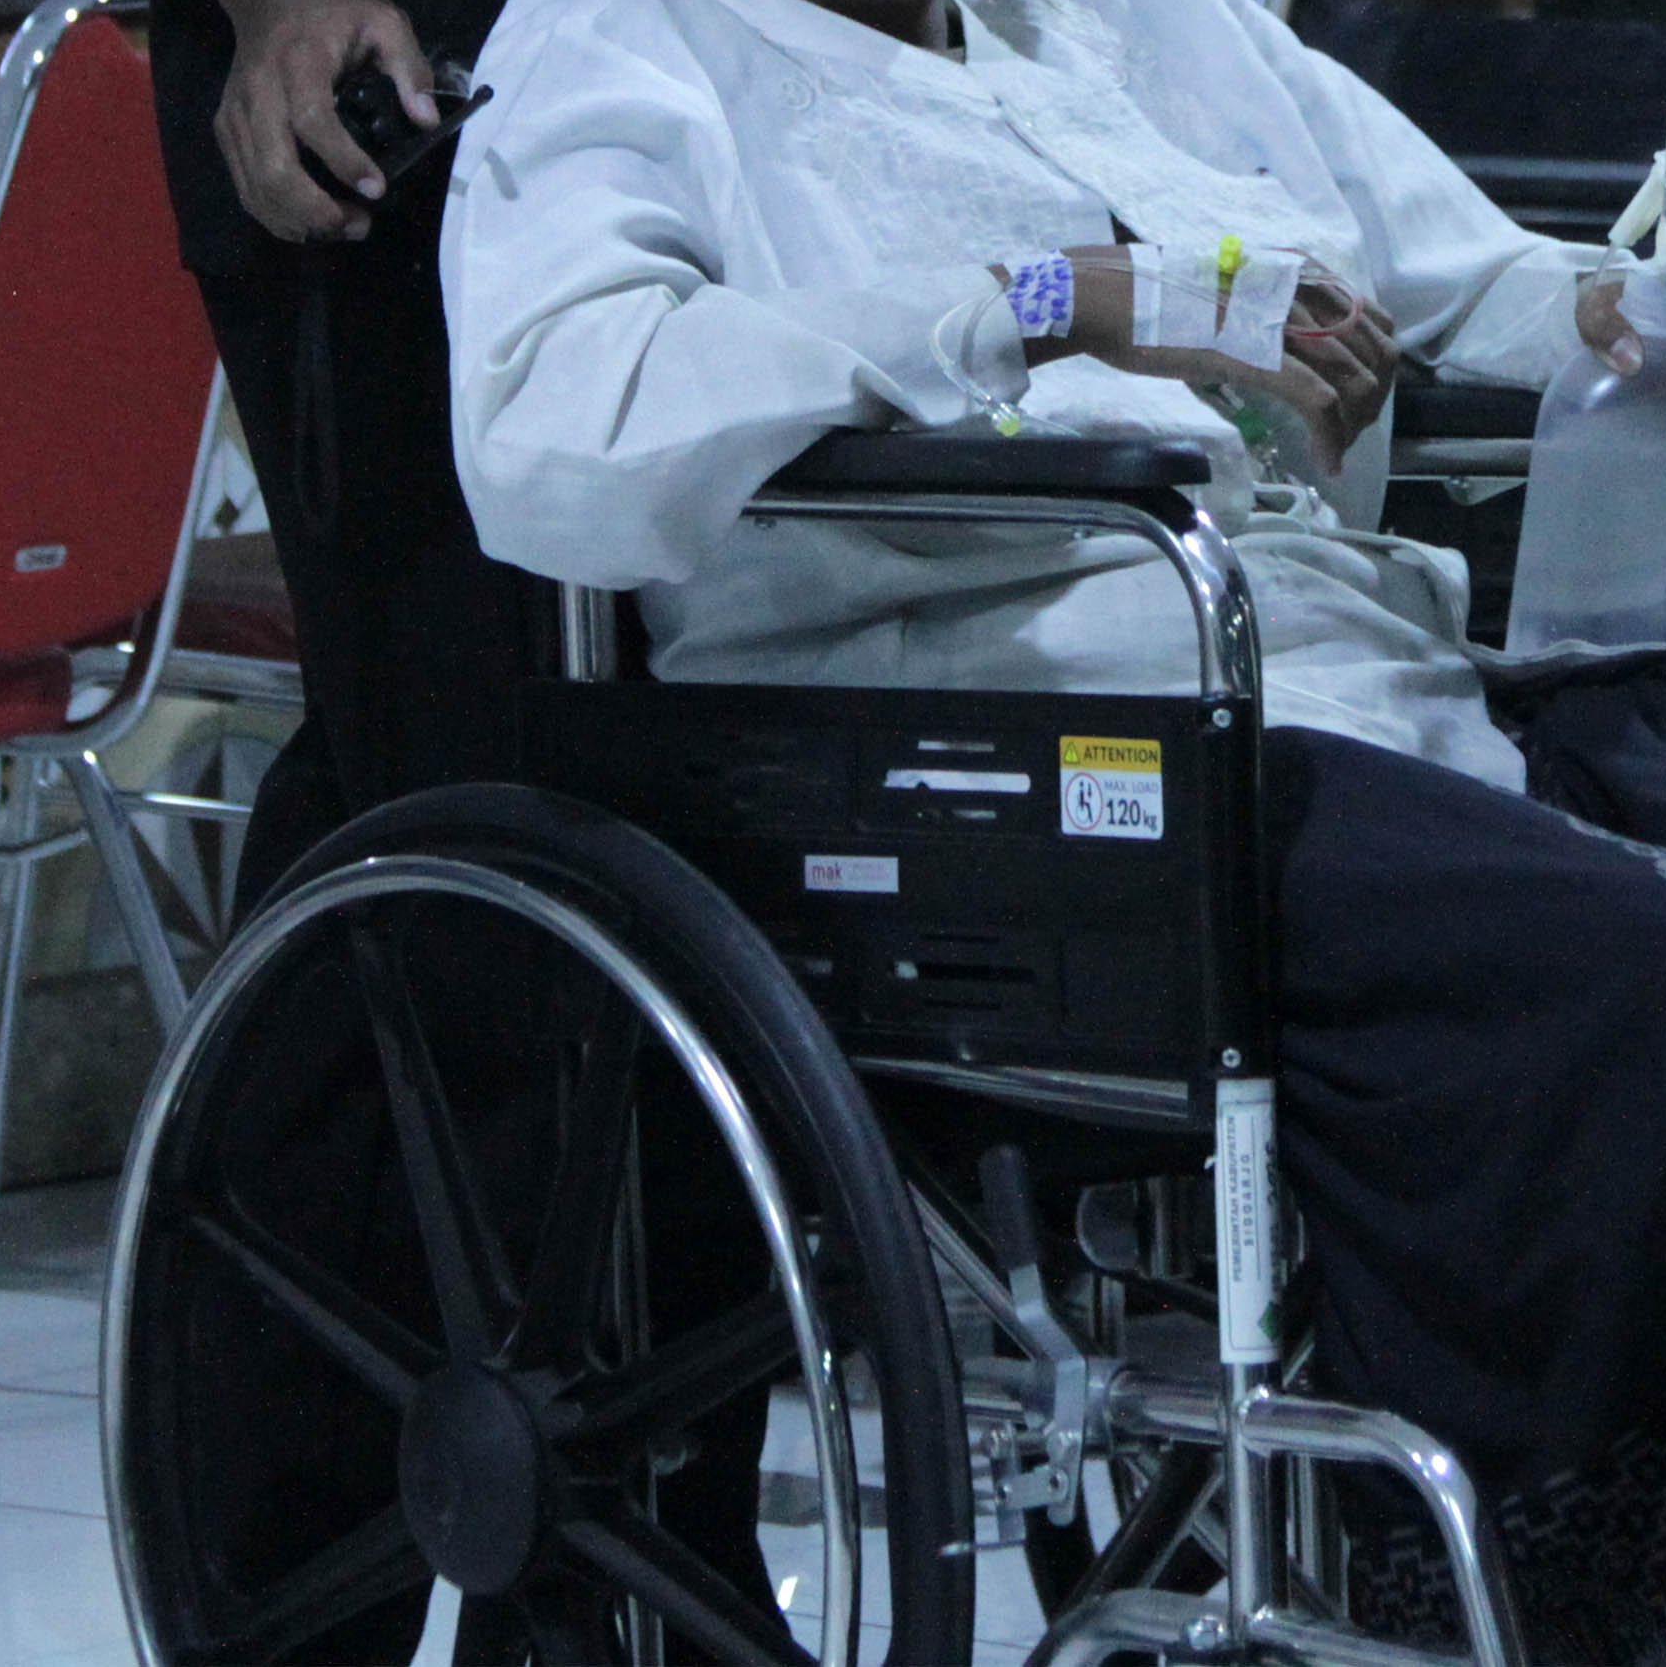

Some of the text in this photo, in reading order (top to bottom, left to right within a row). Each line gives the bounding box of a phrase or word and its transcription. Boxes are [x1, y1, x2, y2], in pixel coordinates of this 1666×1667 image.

[1084, 745, 1158, 764] ATTENTION
[1132, 781, 1159, 794] LOAD
[1106, 798, 1141, 826] 120
[812, 862, 843, 881] mak
[1240, 1152, 1255, 1247] SIDOARJO
